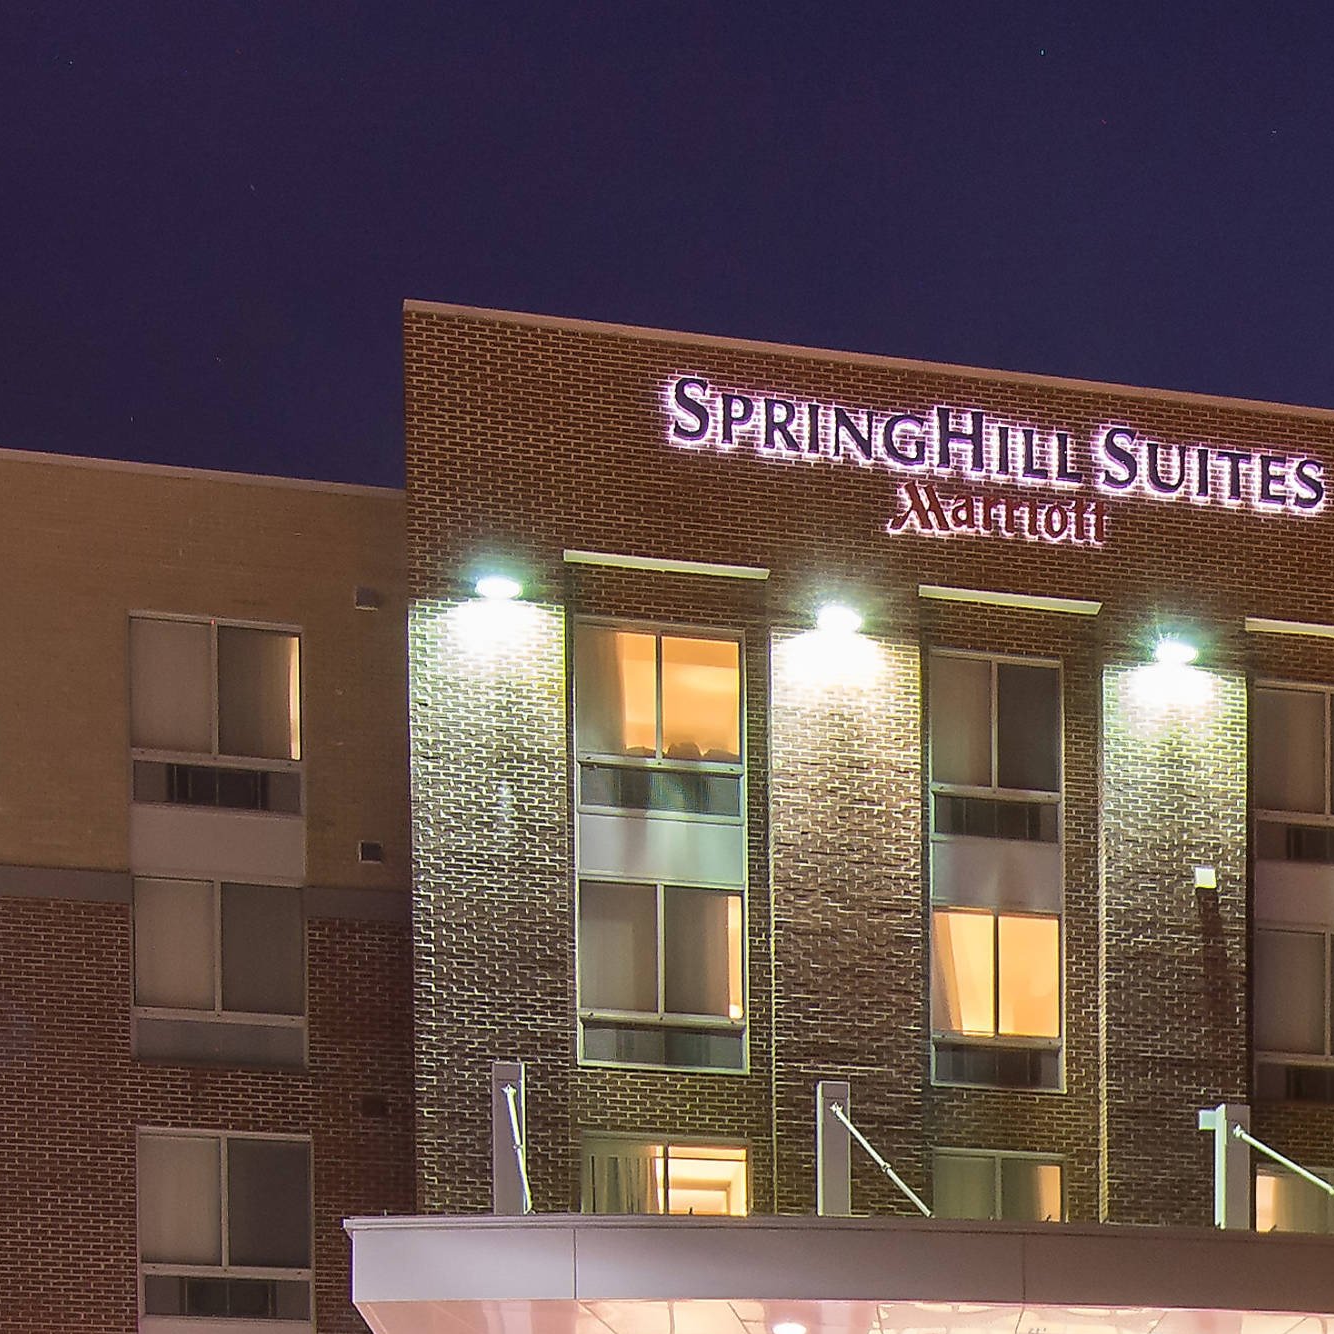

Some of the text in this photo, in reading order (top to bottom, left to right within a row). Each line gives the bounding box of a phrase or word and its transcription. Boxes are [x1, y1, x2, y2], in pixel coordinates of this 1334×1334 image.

[672, 376, 1325, 510] SPRINGHILL SUITES
[890, 480, 1106, 543] Marriott
